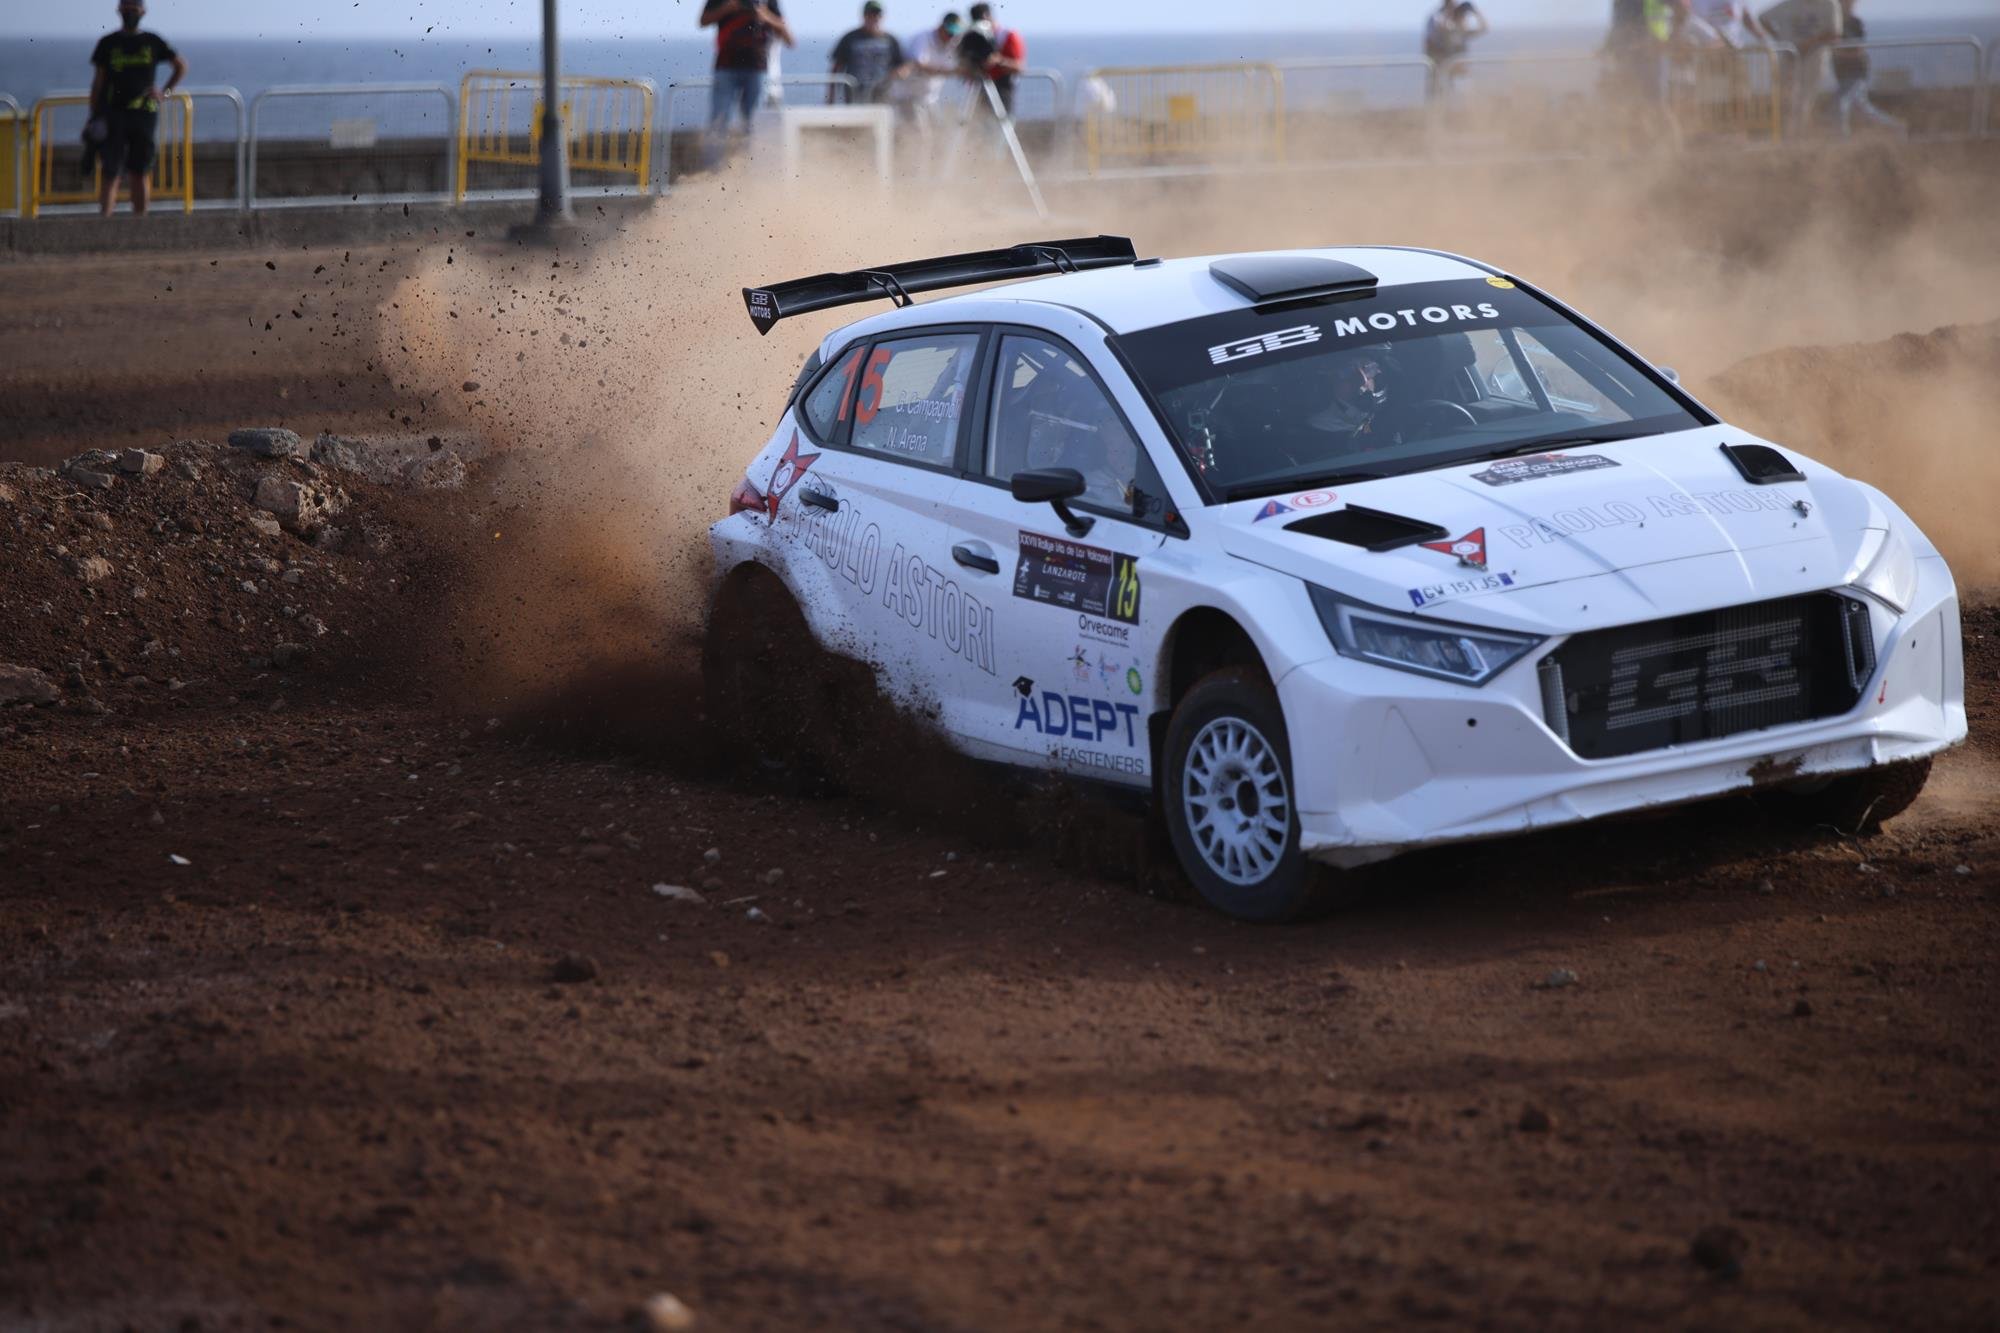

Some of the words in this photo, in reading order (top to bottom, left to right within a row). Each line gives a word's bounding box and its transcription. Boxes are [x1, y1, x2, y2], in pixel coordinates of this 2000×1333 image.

[750, 304, 771, 319] MOTORS
[1208, 325, 1322, 365] GB
[1334, 303, 1499, 337] MOTORS
[837, 346, 893, 426] 15
[887, 426, 897, 448] N.
[899, 428, 928, 452] Arena
[1497, 500, 1646, 549] PAOLO
[1646, 488, 1798, 518] ASTORI
[1042, 563, 1087, 583] LANZAROTE
[1117, 559, 1138, 618] 15
[1451, 581, 1477, 593] 151
[1481, 576, 1500, 590] JS
[883, 543, 997, 677] ASTORI
[1015, 691, 1139, 748] ADEPT
[1061, 747, 1145, 775] FASTENERS
